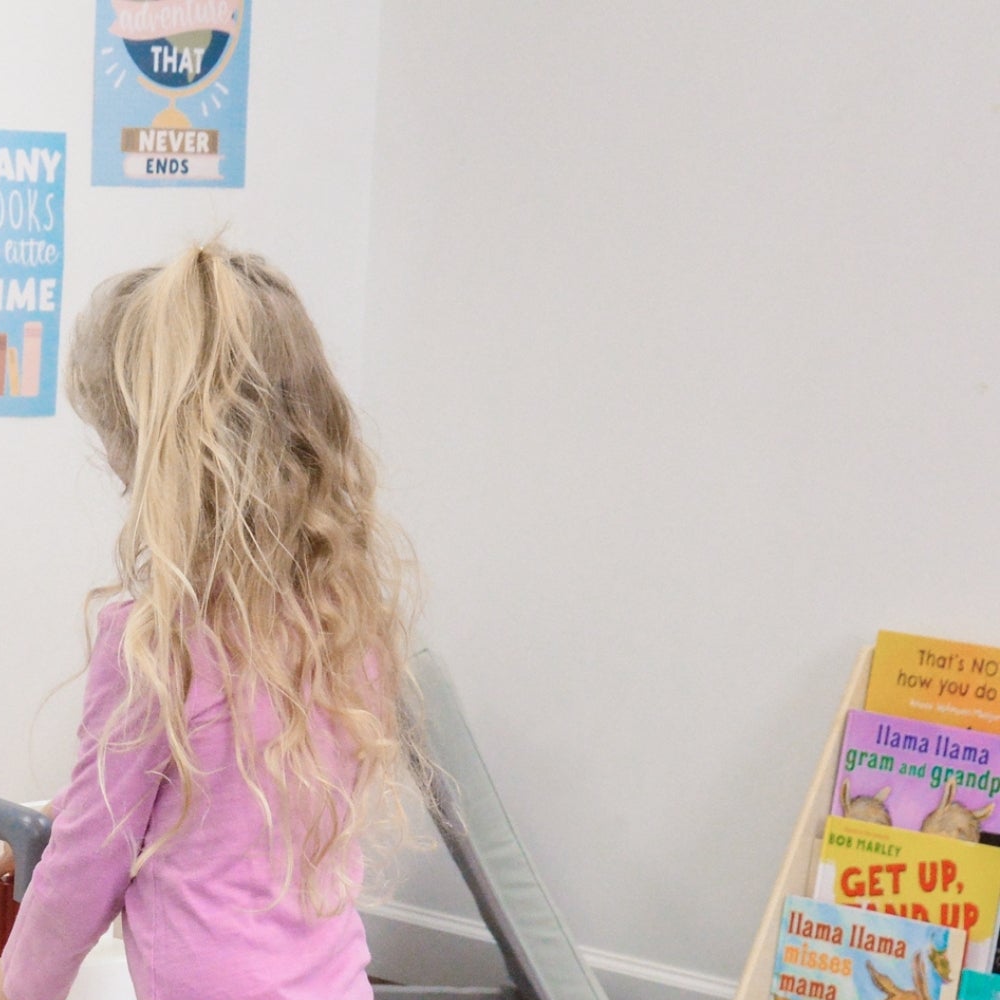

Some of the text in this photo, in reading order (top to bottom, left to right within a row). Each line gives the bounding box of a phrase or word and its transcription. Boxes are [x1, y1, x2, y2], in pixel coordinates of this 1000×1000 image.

[151, 45, 205, 75] THAT
[138, 129, 210, 153] NEVER
[146, 158, 189, 174] ENDS
[4, 239, 60, 264] little
[918, 649, 965, 672] That's
[896, 668, 997, 701] how you do
[876, 724, 990, 766] llama llama
[845, 748, 895, 772] gram
[899, 762, 927, 778] and
[828, 832, 852, 848] BOB
[857, 838, 903, 857] MARLEY
[840, 859, 964, 897] GET UP,
[788, 911, 844, 945] llama
[849, 924, 907, 959] llama
[783, 942, 852, 976] misses
